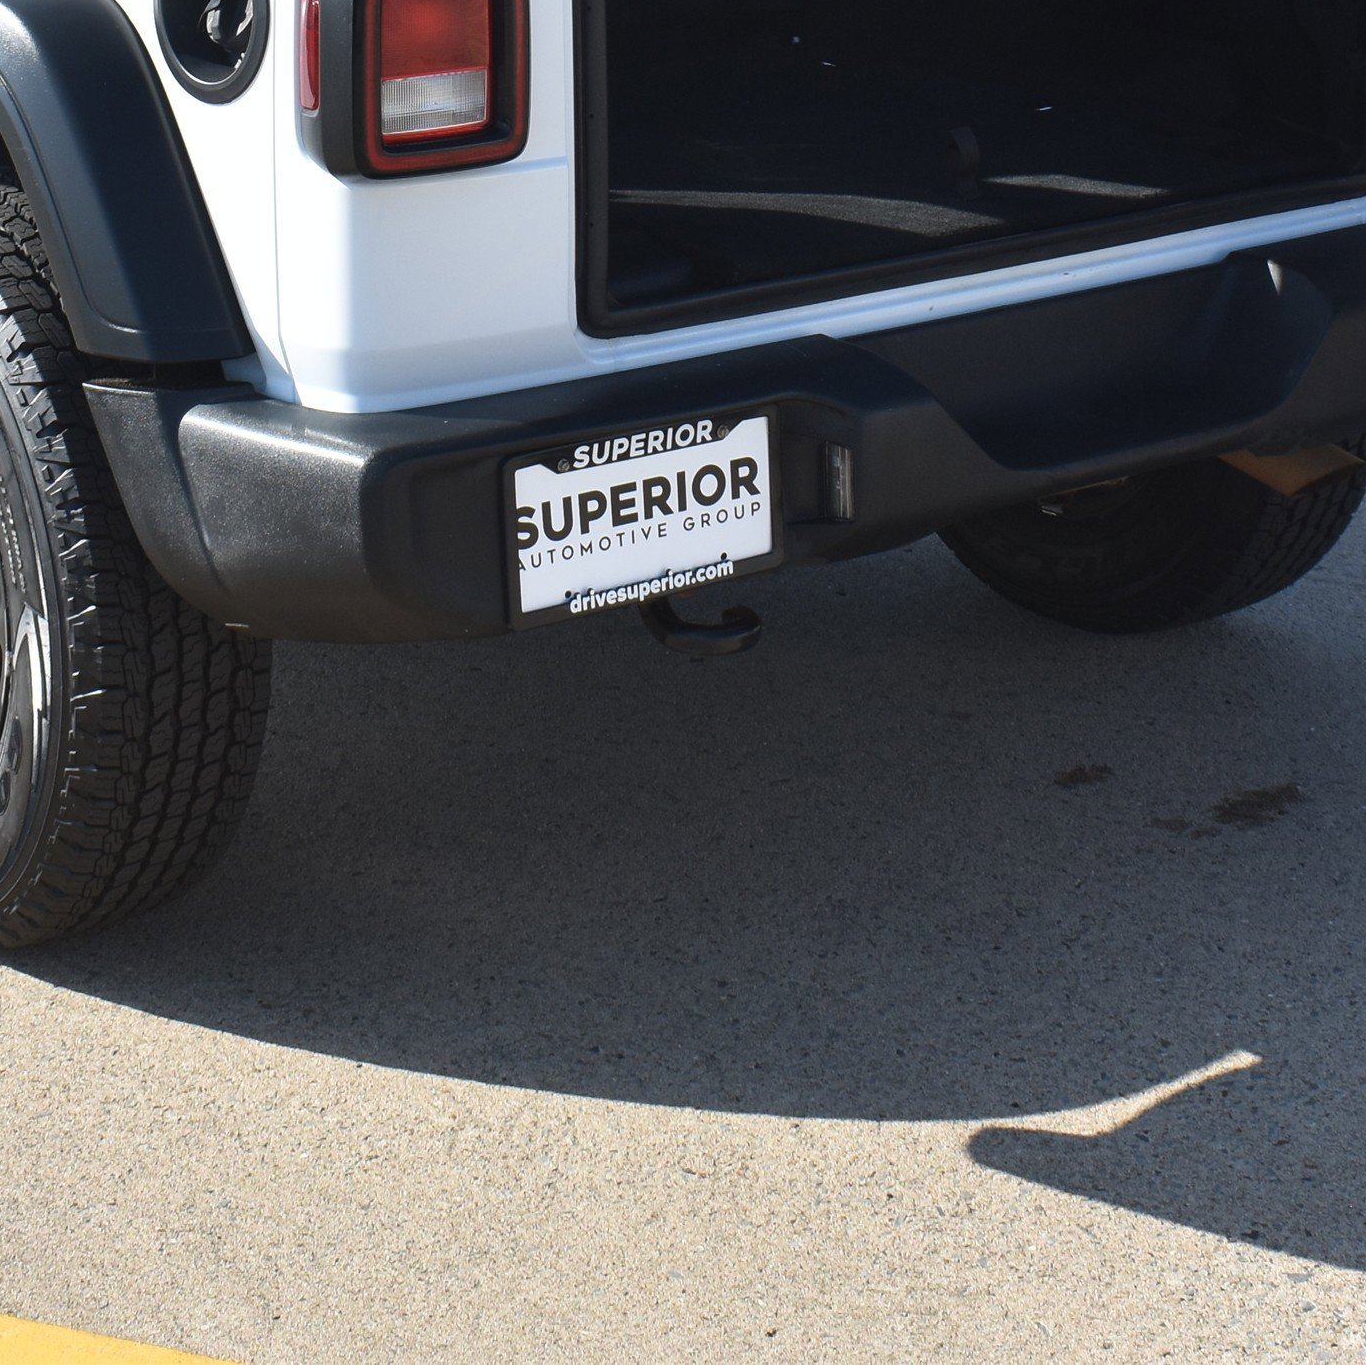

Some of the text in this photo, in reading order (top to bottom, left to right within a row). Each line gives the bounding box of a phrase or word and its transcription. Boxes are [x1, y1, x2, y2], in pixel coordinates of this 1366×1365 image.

[573, 419, 713, 469] SUPERIOR
[516, 456, 761, 550] SUPERIOR
[683, 501, 761, 532] GROUP
[569, 558, 734, 614] drivesuperior.com
